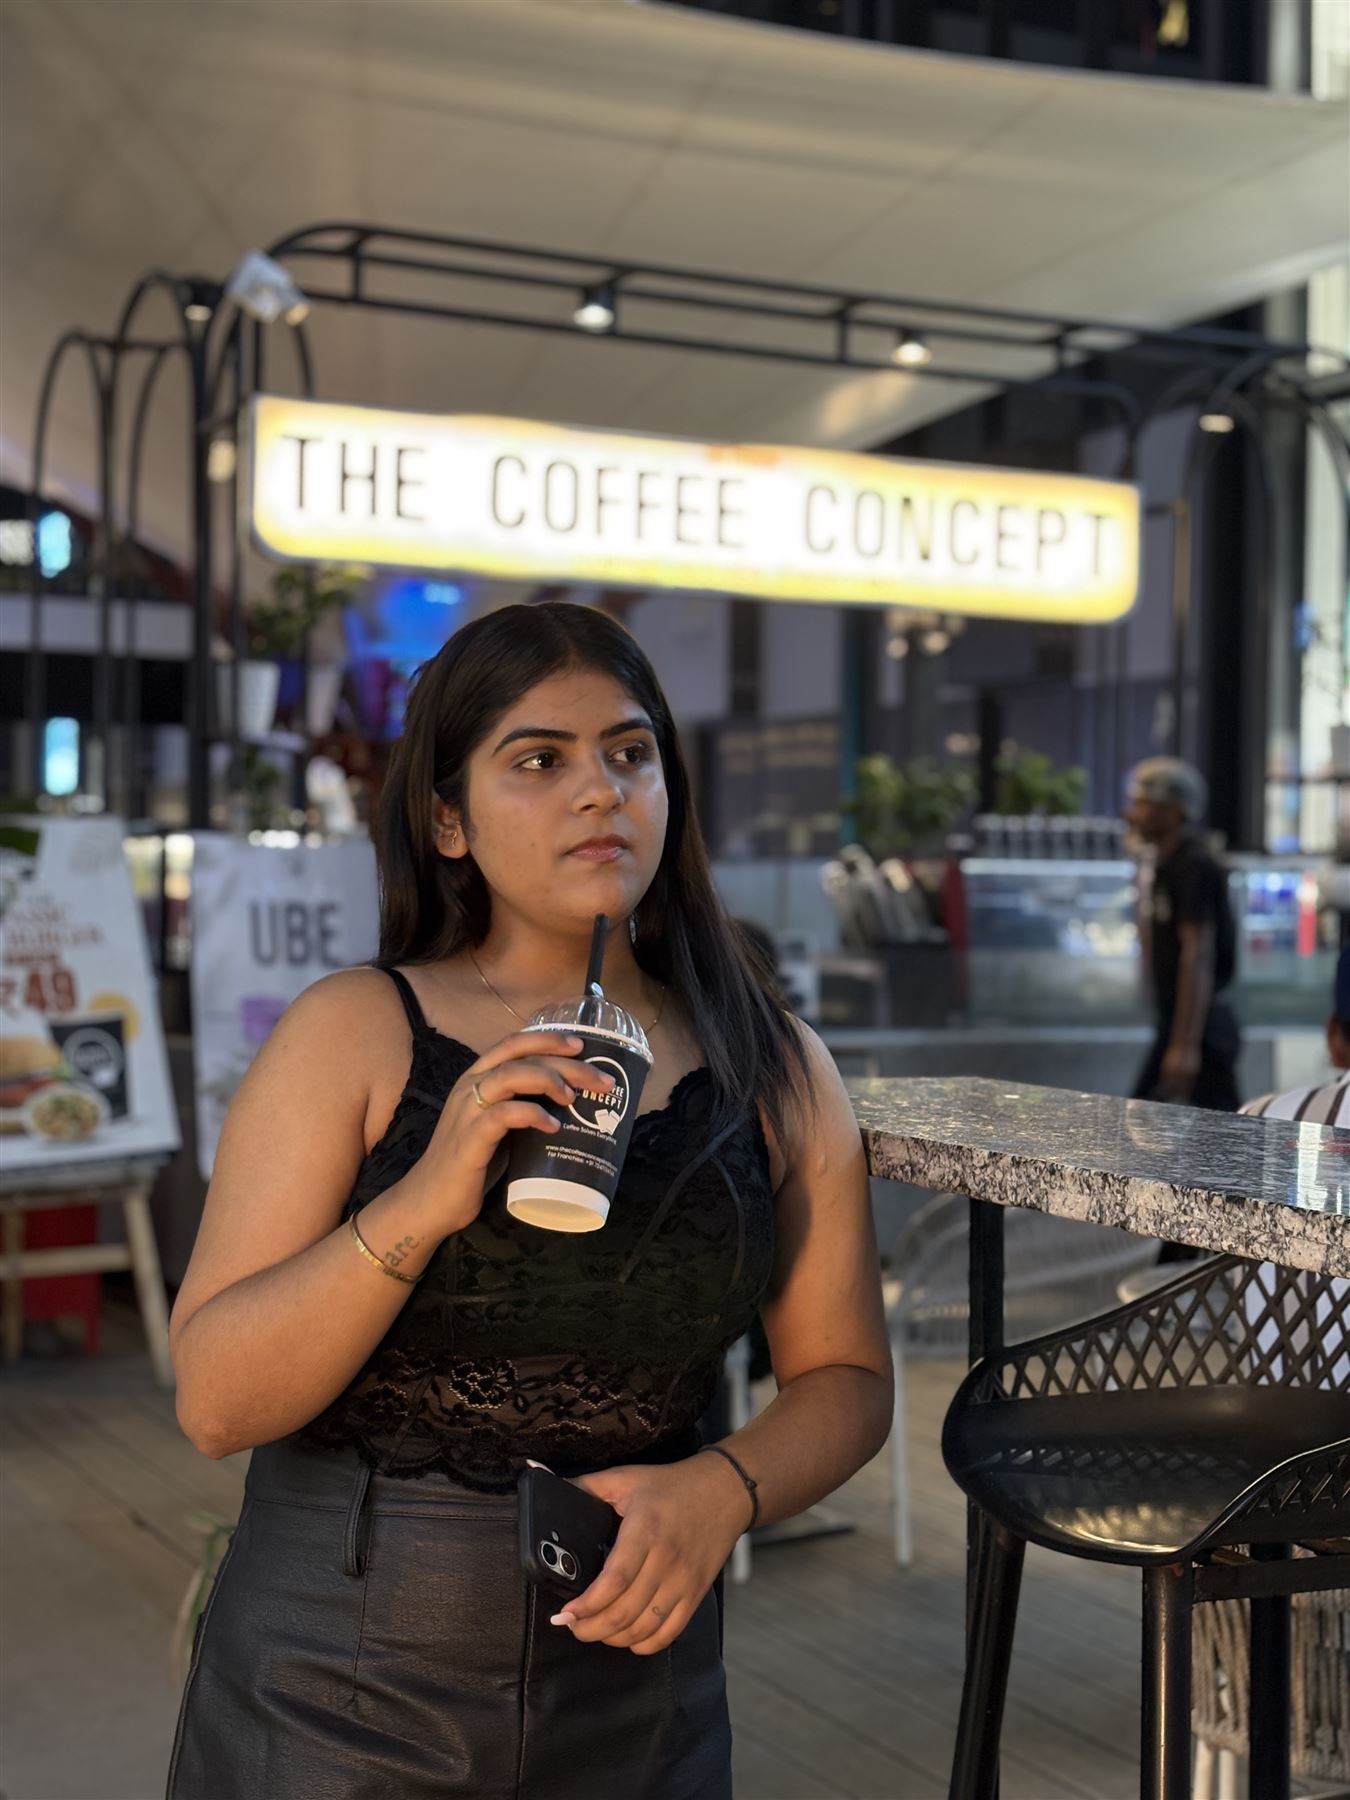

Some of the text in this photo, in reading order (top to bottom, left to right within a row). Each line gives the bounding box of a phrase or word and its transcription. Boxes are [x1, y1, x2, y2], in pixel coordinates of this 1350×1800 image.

[280, 434, 1116, 577] THE COFFEE CONCEPT
[251, 900, 342, 969] UBE
[563, 1123, 580, 1132] Coffee
[580, 1126, 596, 1136] Solves
